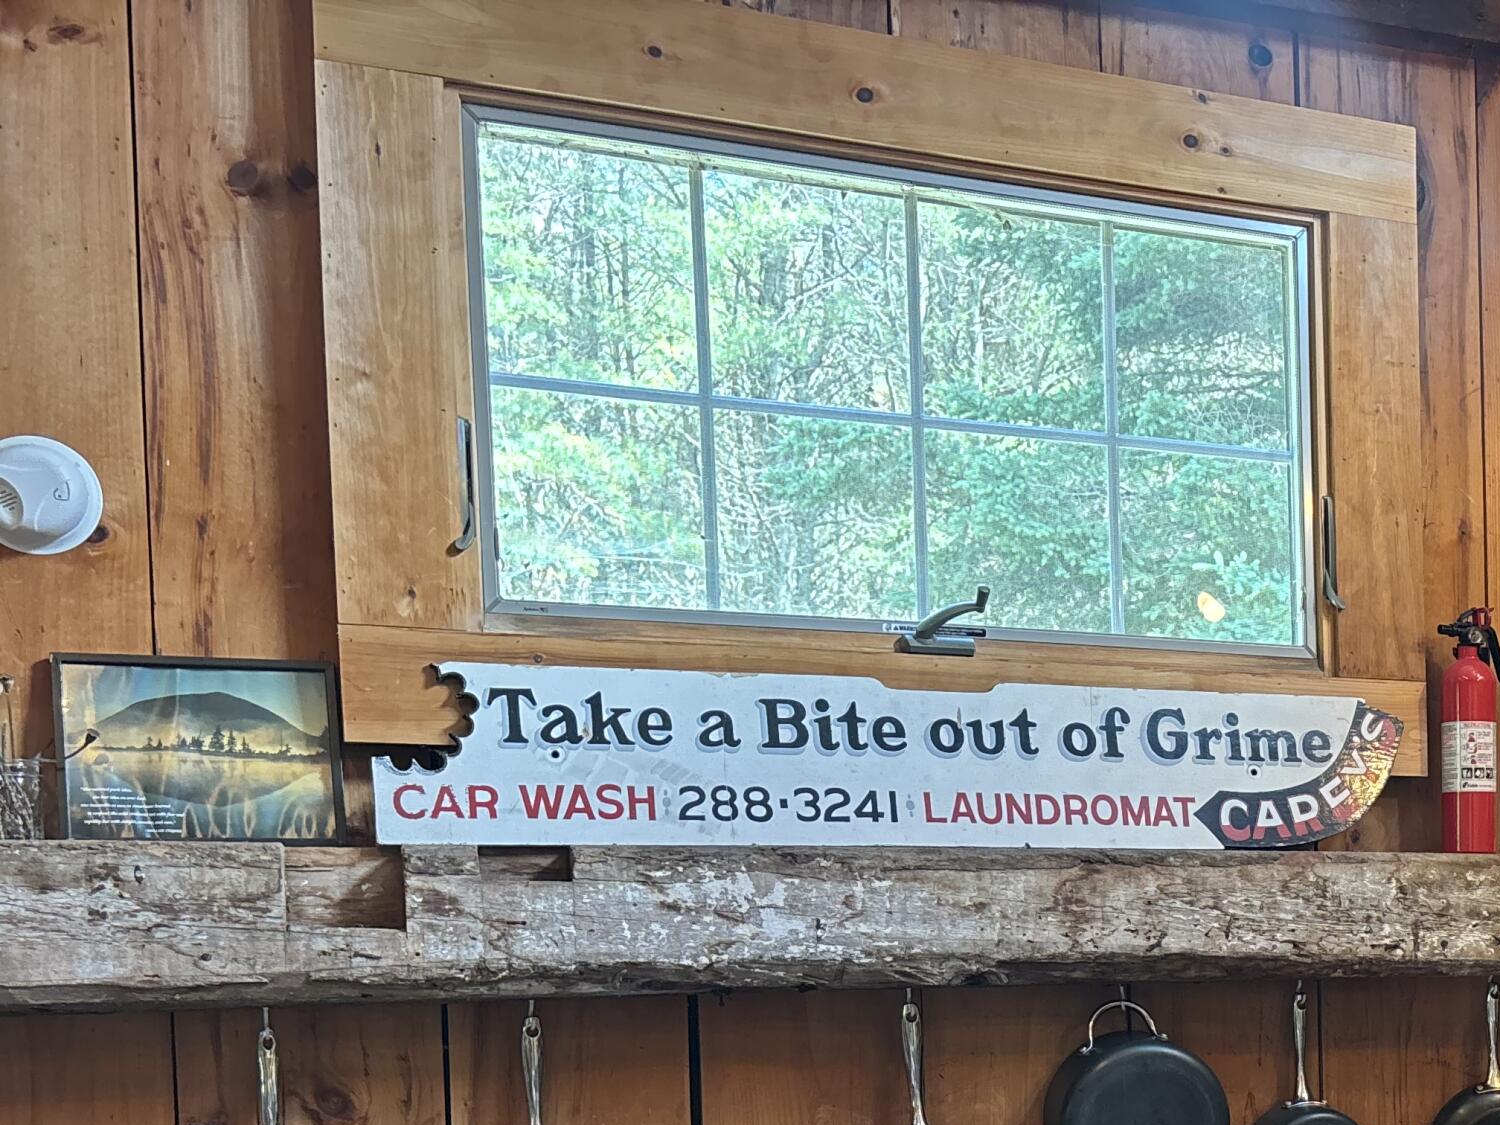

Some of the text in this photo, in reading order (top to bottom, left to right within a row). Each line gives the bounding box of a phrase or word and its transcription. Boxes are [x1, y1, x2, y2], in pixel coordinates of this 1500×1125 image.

[484, 687, 1334, 765] Take a Bite out of Grime
[392, 784, 499, 820] CAR
[518, 784, 657, 821] WASH
[922, 791, 1196, 828] LAUNDROMAT
